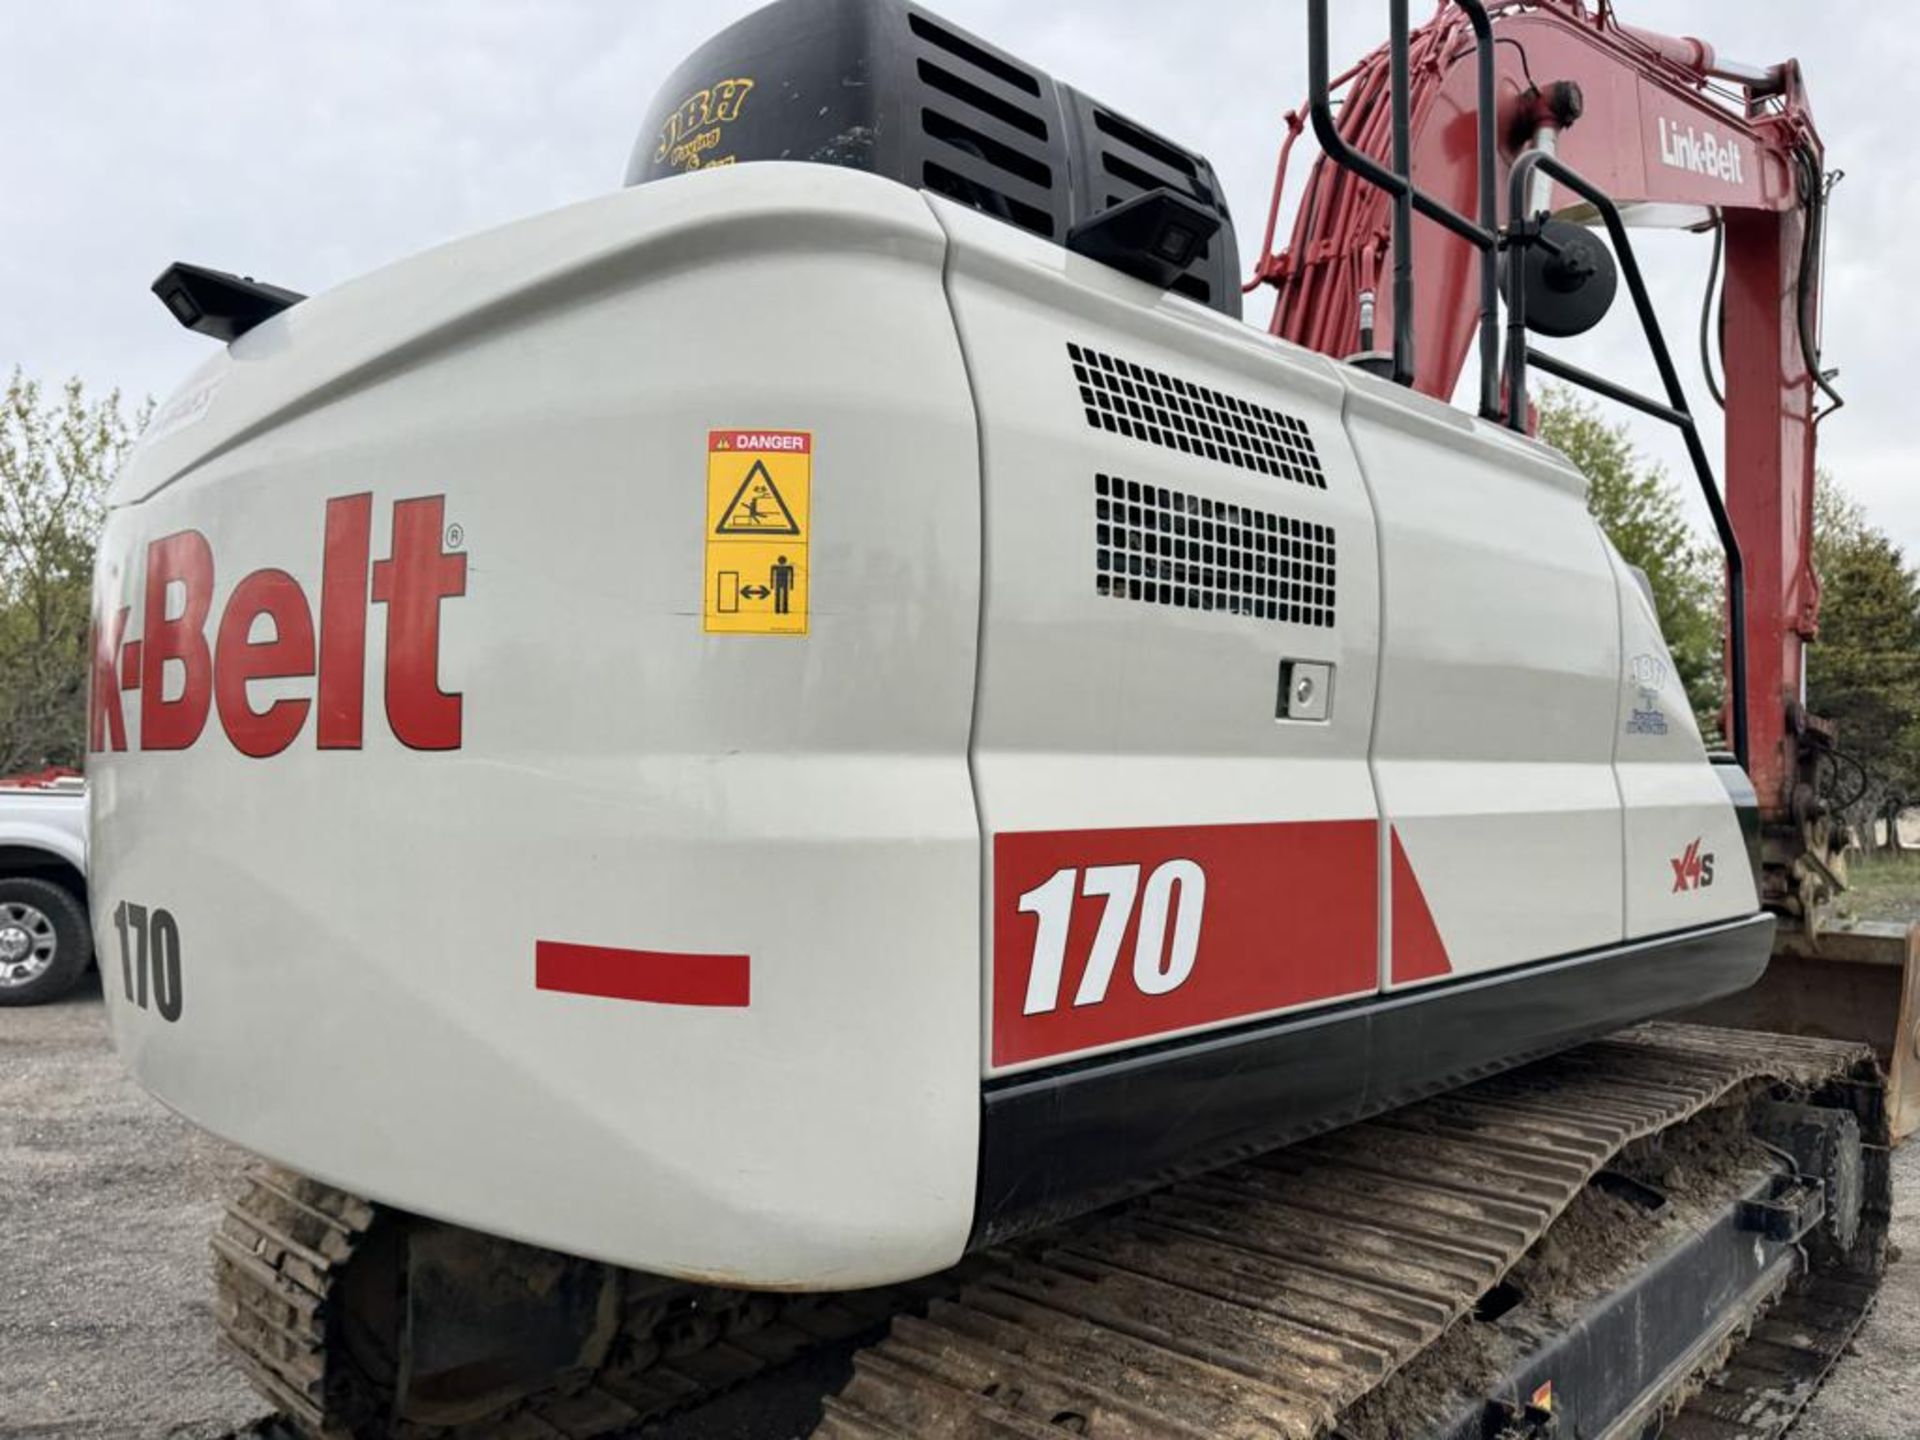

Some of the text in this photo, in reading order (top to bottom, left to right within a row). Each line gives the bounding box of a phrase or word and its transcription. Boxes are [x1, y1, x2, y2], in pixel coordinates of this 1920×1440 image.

[1658, 116, 1743, 184] Link-Belt
[736, 434, 804, 450] DANGER
[113, 899, 183, 1023] 170
[1018, 858, 1206, 1016] 170
